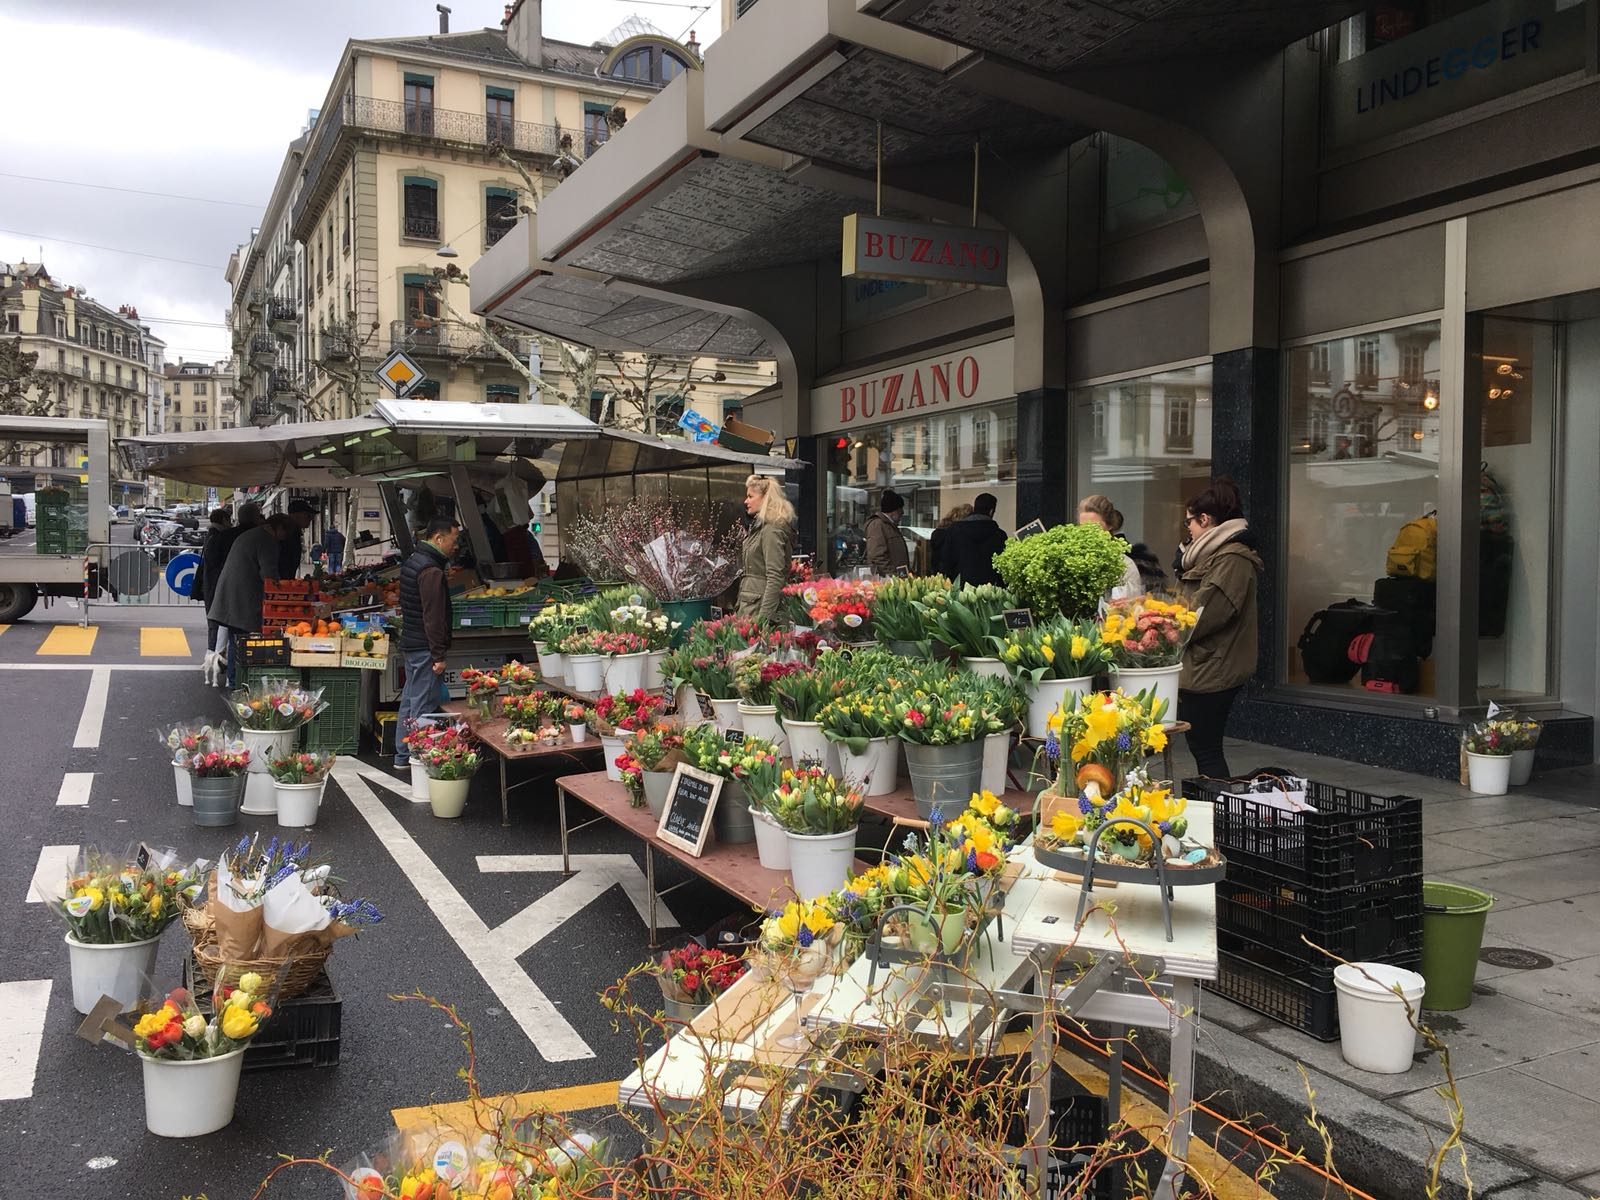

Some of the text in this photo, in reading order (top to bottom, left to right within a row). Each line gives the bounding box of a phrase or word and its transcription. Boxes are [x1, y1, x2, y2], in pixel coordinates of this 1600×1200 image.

[1356, 19, 1542, 115] LINDEGGER
[864, 231, 1001, 271] BUZZANO
[839, 355, 980, 423] BUZZANO
[344, 659, 385, 668] BIOLOGICO
